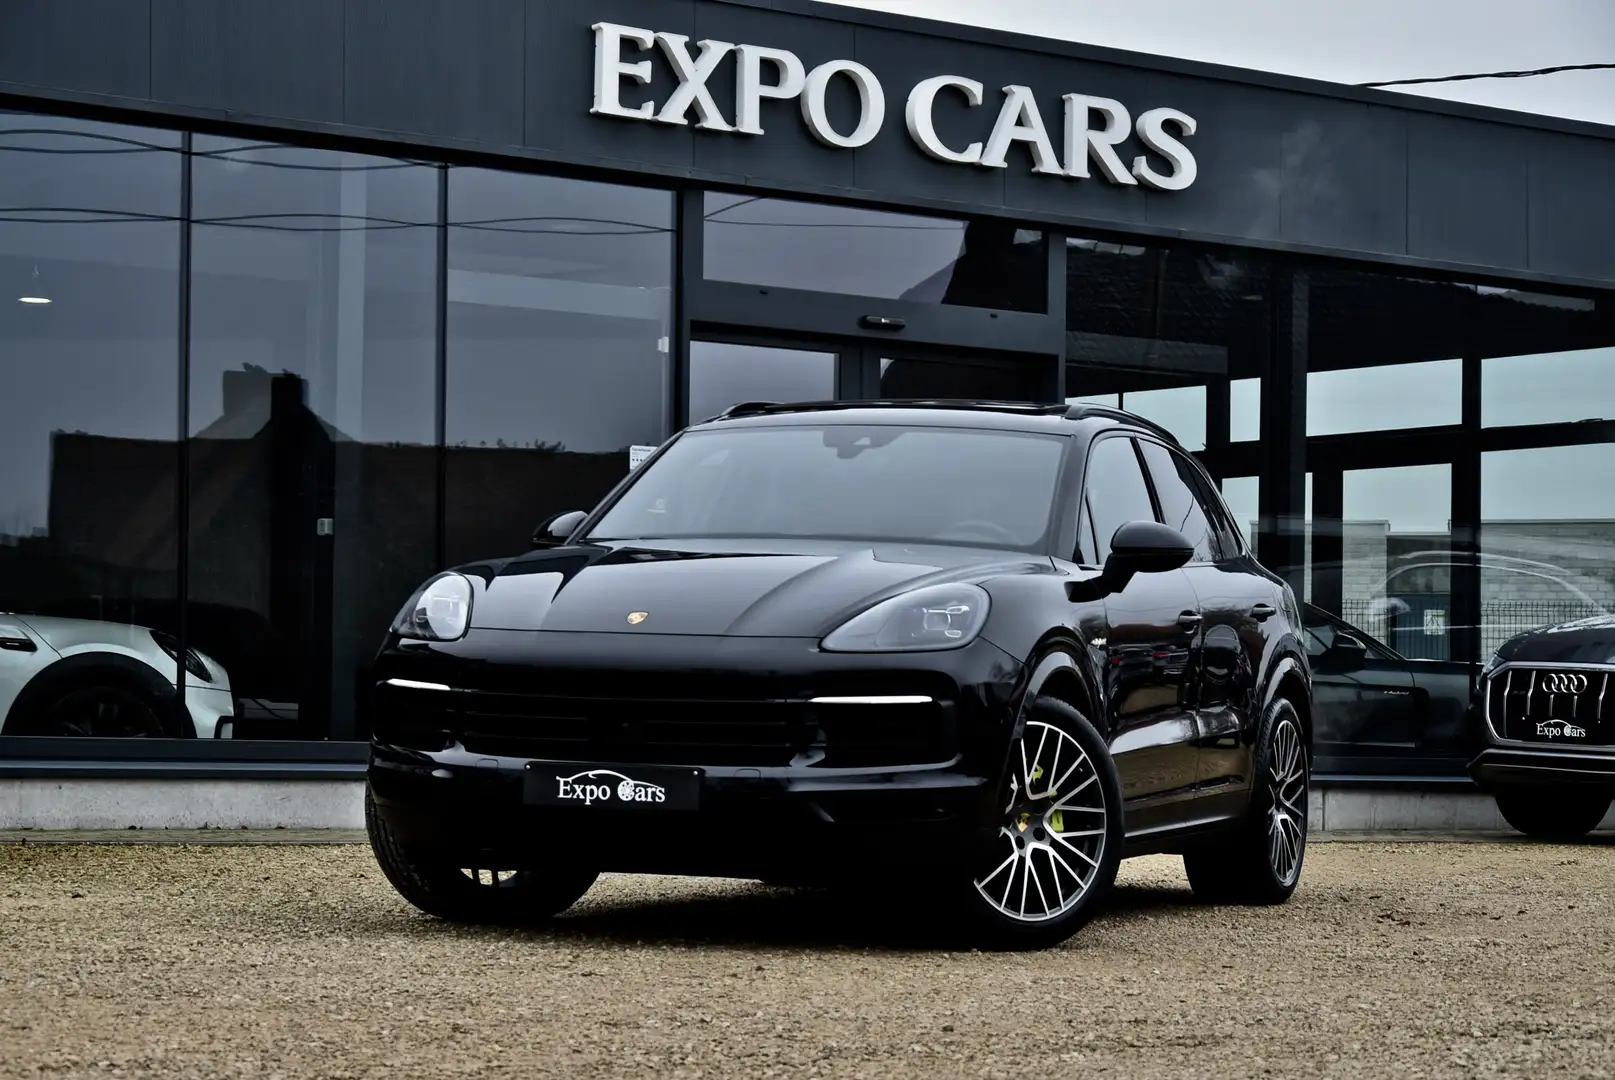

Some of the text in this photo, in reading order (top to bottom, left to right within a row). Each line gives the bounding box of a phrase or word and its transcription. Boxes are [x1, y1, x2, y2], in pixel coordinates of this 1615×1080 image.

[589, 22, 1197, 191] EXPO CARS
[1536, 723, 1586, 738] Expo Cars
[556, 778, 666, 805] Expo Cars
